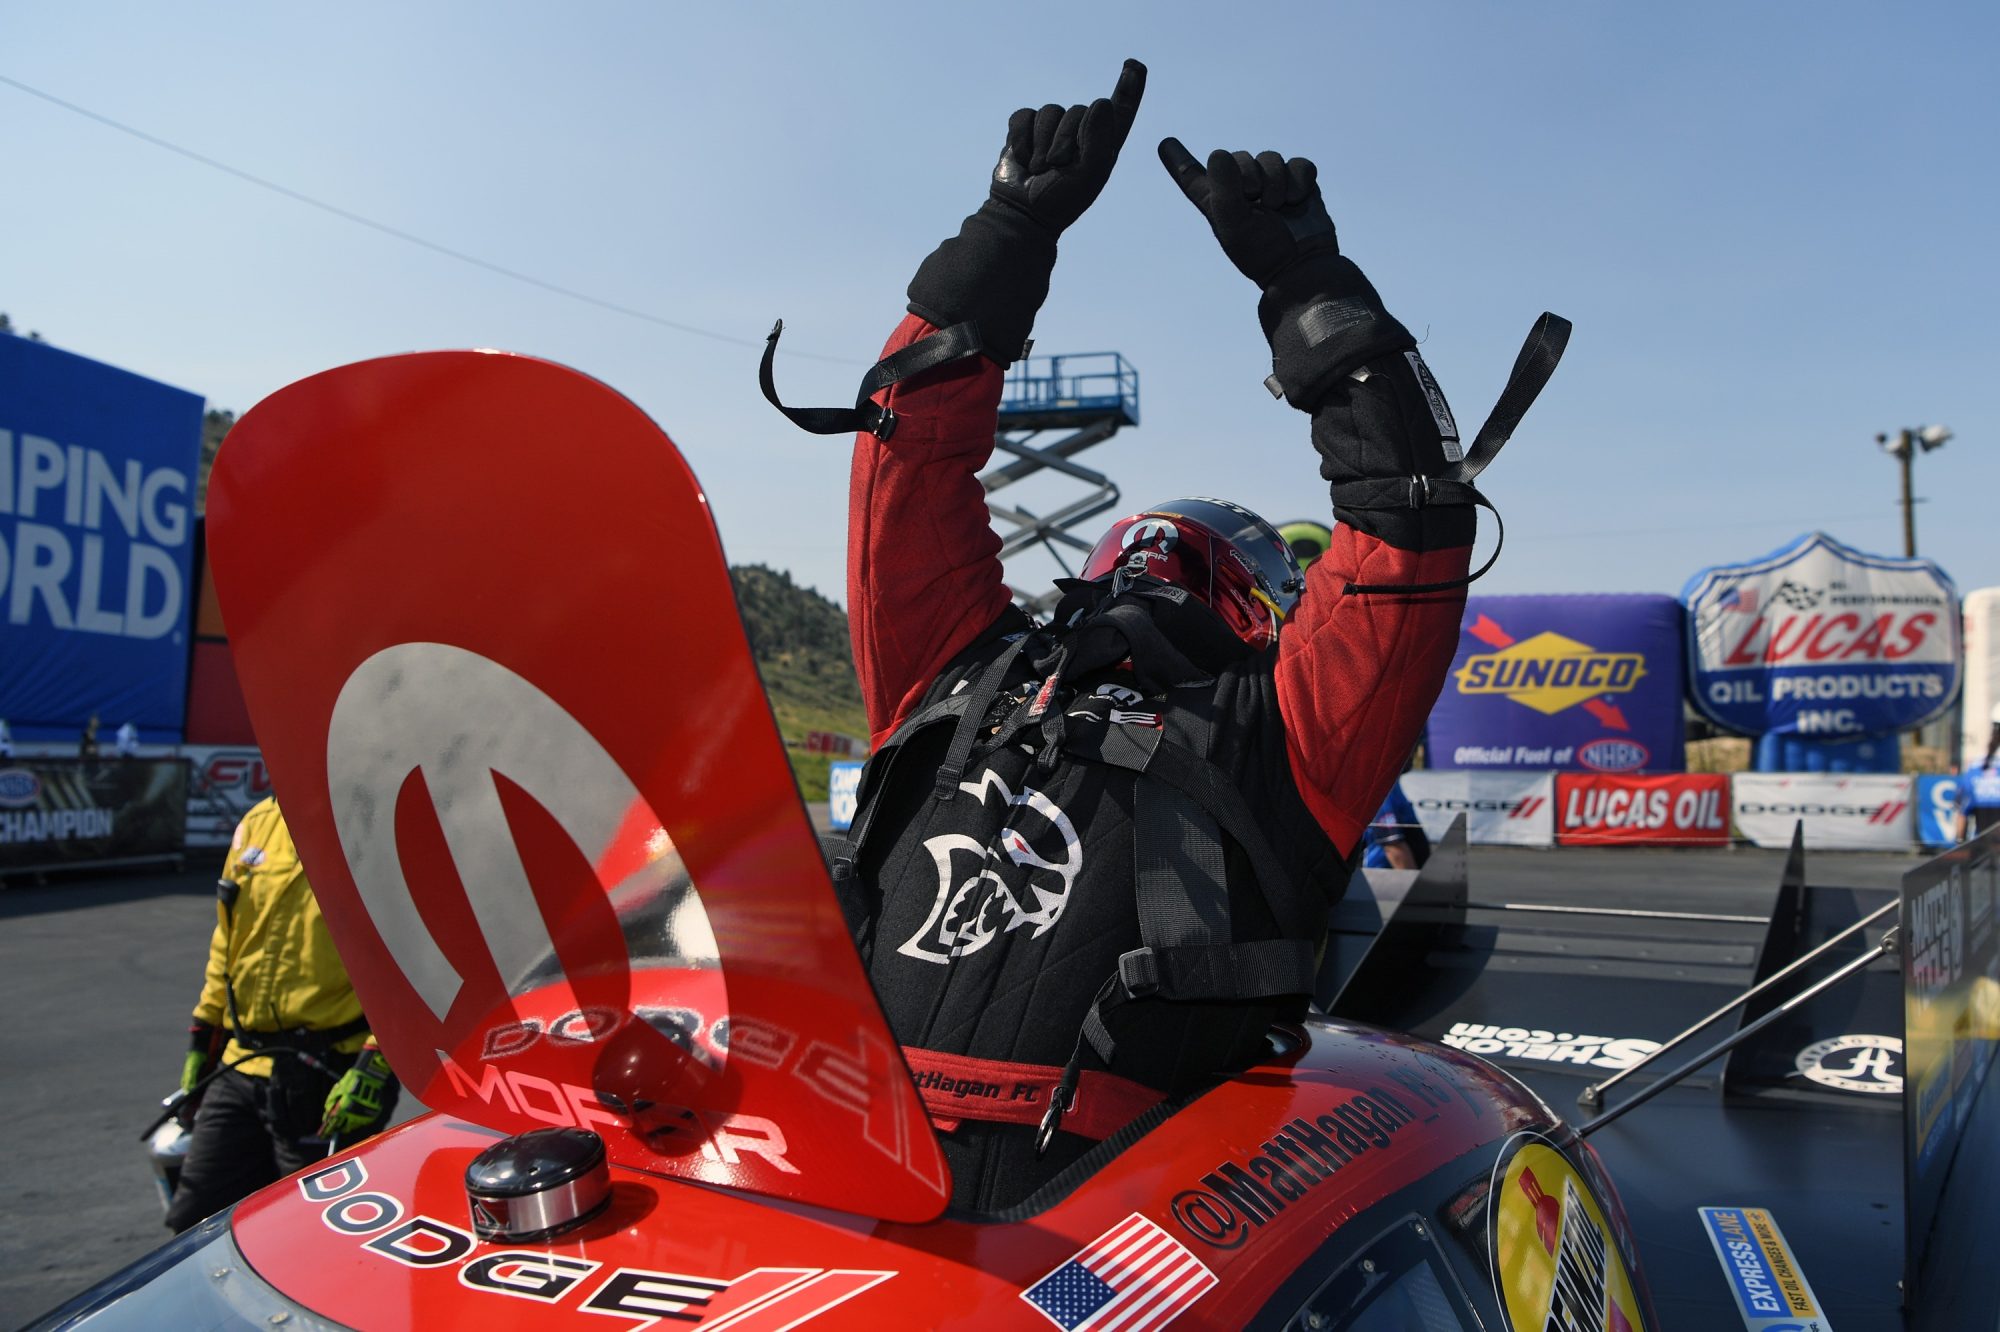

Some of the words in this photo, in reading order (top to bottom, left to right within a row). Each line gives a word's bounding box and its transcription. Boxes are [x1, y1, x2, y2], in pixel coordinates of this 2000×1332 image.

[0, 522, 183, 641] RLD
[1723, 611, 1938, 667] LUCAS
[1464, 657, 1638, 689] SUNOCO
[1709, 680, 1763, 704] OIL
[1772, 673, 1944, 701] PRODUCTS
[1454, 746, 1512, 765] Official
[1514, 747, 1552, 765] Fuel
[1553, 746, 1574, 765] of
[1583, 742, 1643, 768] NHRA
[1417, 798, 1522, 811] ODGE
[1564, 787, 1669, 830] LUCAS
[1673, 788, 1723, 830] OIL
[1740, 801, 1884, 817] DODGE
[297, 1156, 730, 1323] DODGE
[1755, 1222, 1774, 1240] MORE
[1766, 1246, 1793, 1279] CHANGES
[1782, 1279, 1800, 1291] OIL
[1789, 1291, 1810, 1312] FAST
